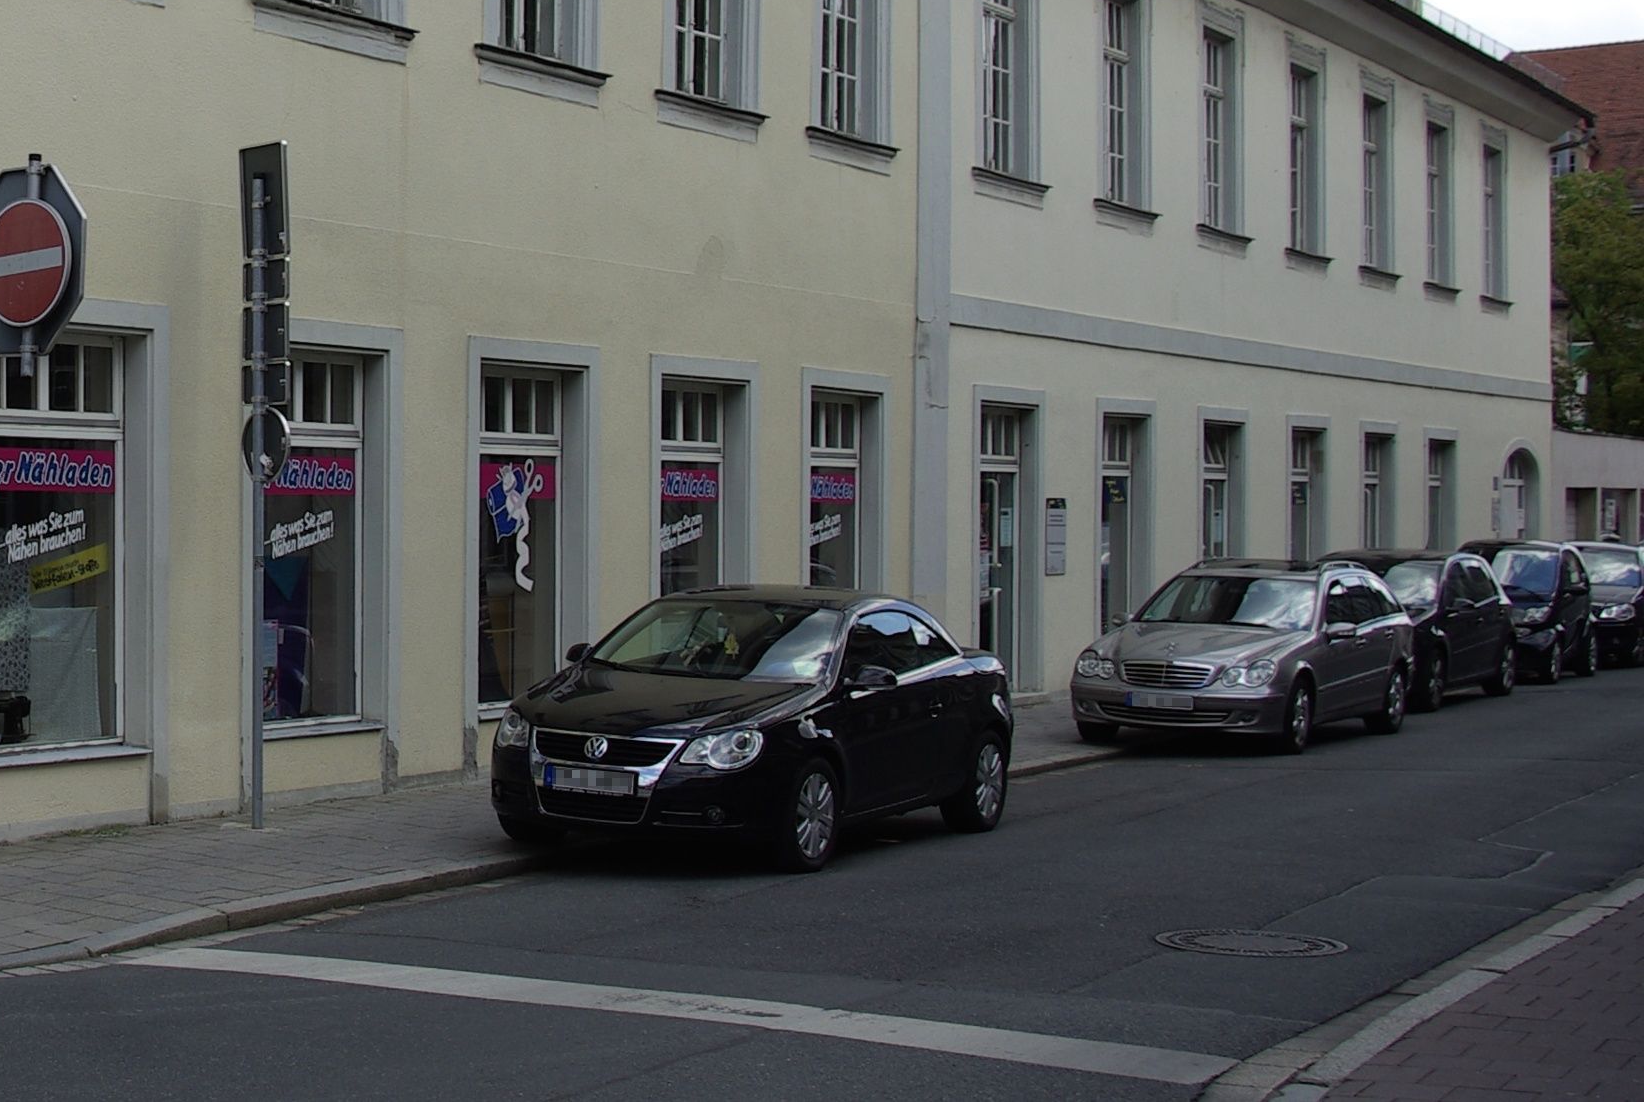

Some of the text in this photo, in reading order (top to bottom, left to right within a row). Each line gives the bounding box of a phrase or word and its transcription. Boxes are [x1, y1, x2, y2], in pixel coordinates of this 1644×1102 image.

[15, 451, 113, 488] Nähladen
[273, 458, 354, 491] Nähladen
[663, 470, 718, 499] Nähladen
[27, 517, 48, 538] was
[48, 511, 64, 532] Sie
[63, 508, 84, 526] zum
[288, 518, 303, 535] was
[303, 511, 316, 529] Sie
[316, 509, 332, 524] zum
[8, 524, 86, 564] Nähen brauchen!
[272, 539, 296, 559] Nähen
